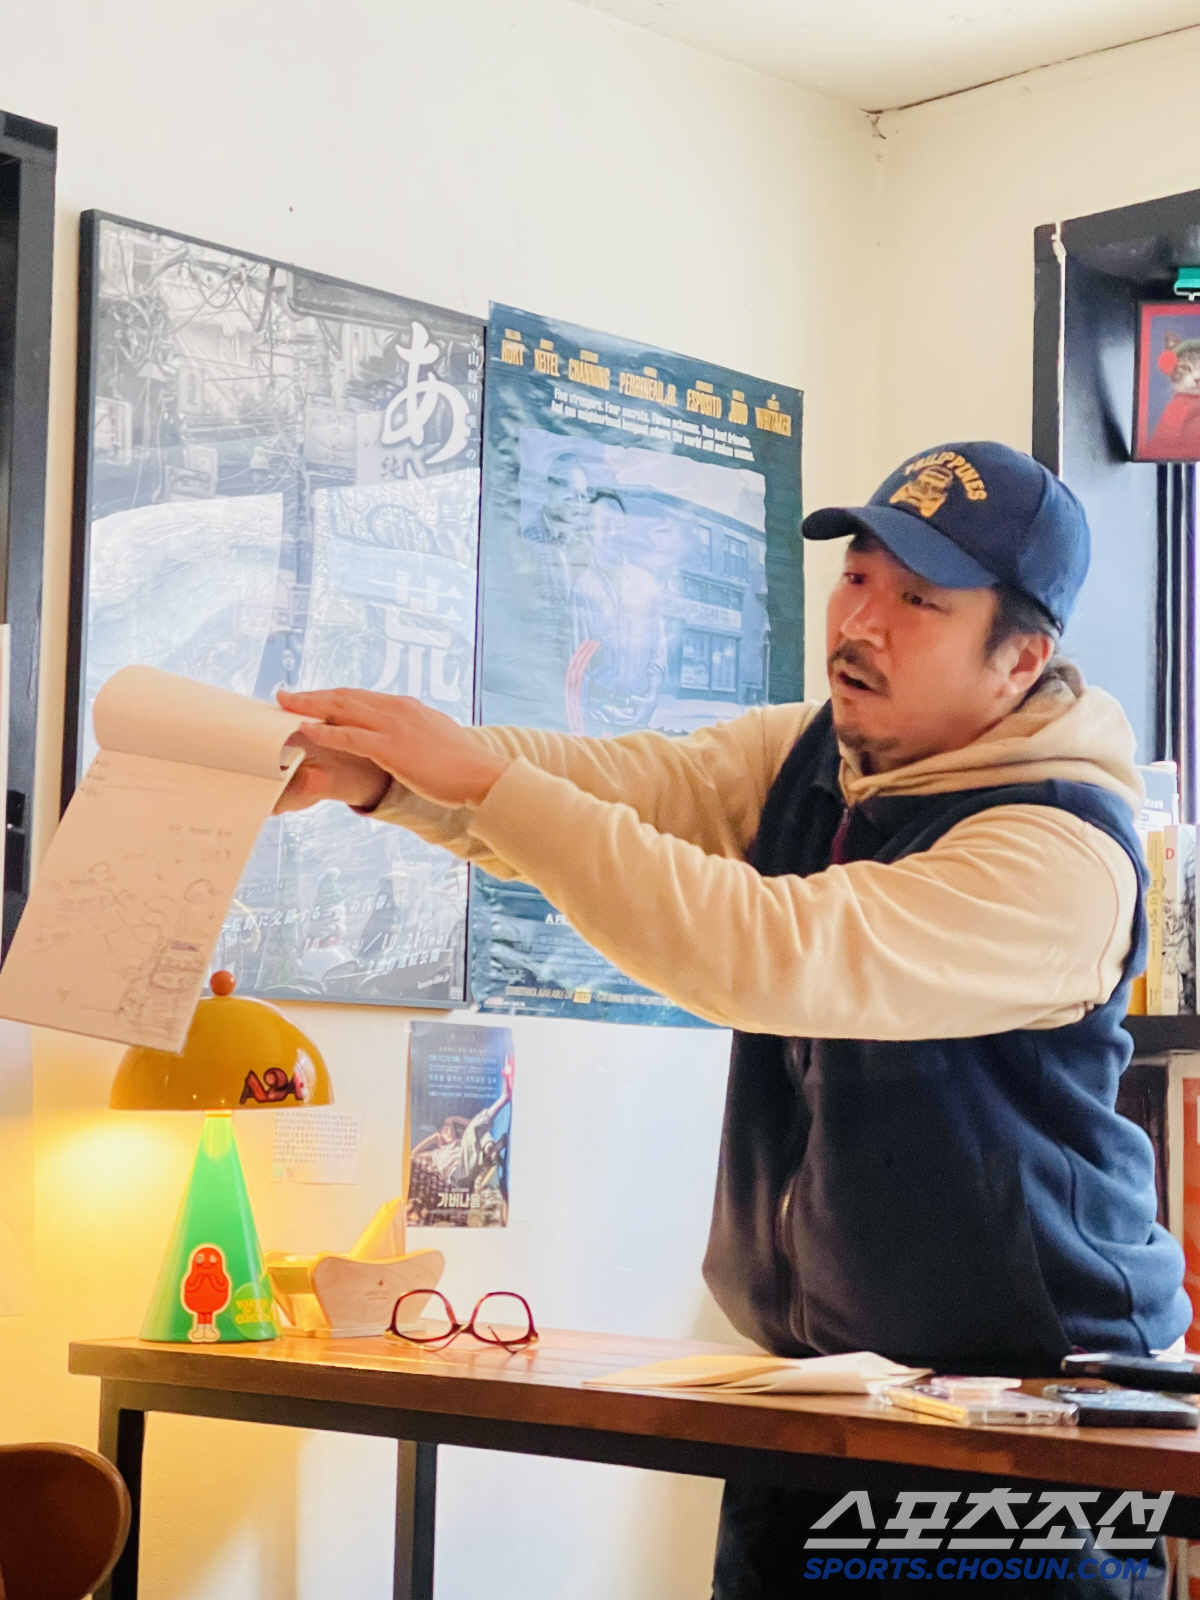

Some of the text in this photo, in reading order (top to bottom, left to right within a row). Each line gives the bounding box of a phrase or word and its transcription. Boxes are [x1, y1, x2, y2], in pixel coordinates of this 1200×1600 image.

[534, 348, 560, 377] KEITEL
[568, 358, 611, 390] CHANNING
[1165, 847, 1175, 861] D
[437, 1192, 481, 1208] 가버나움
